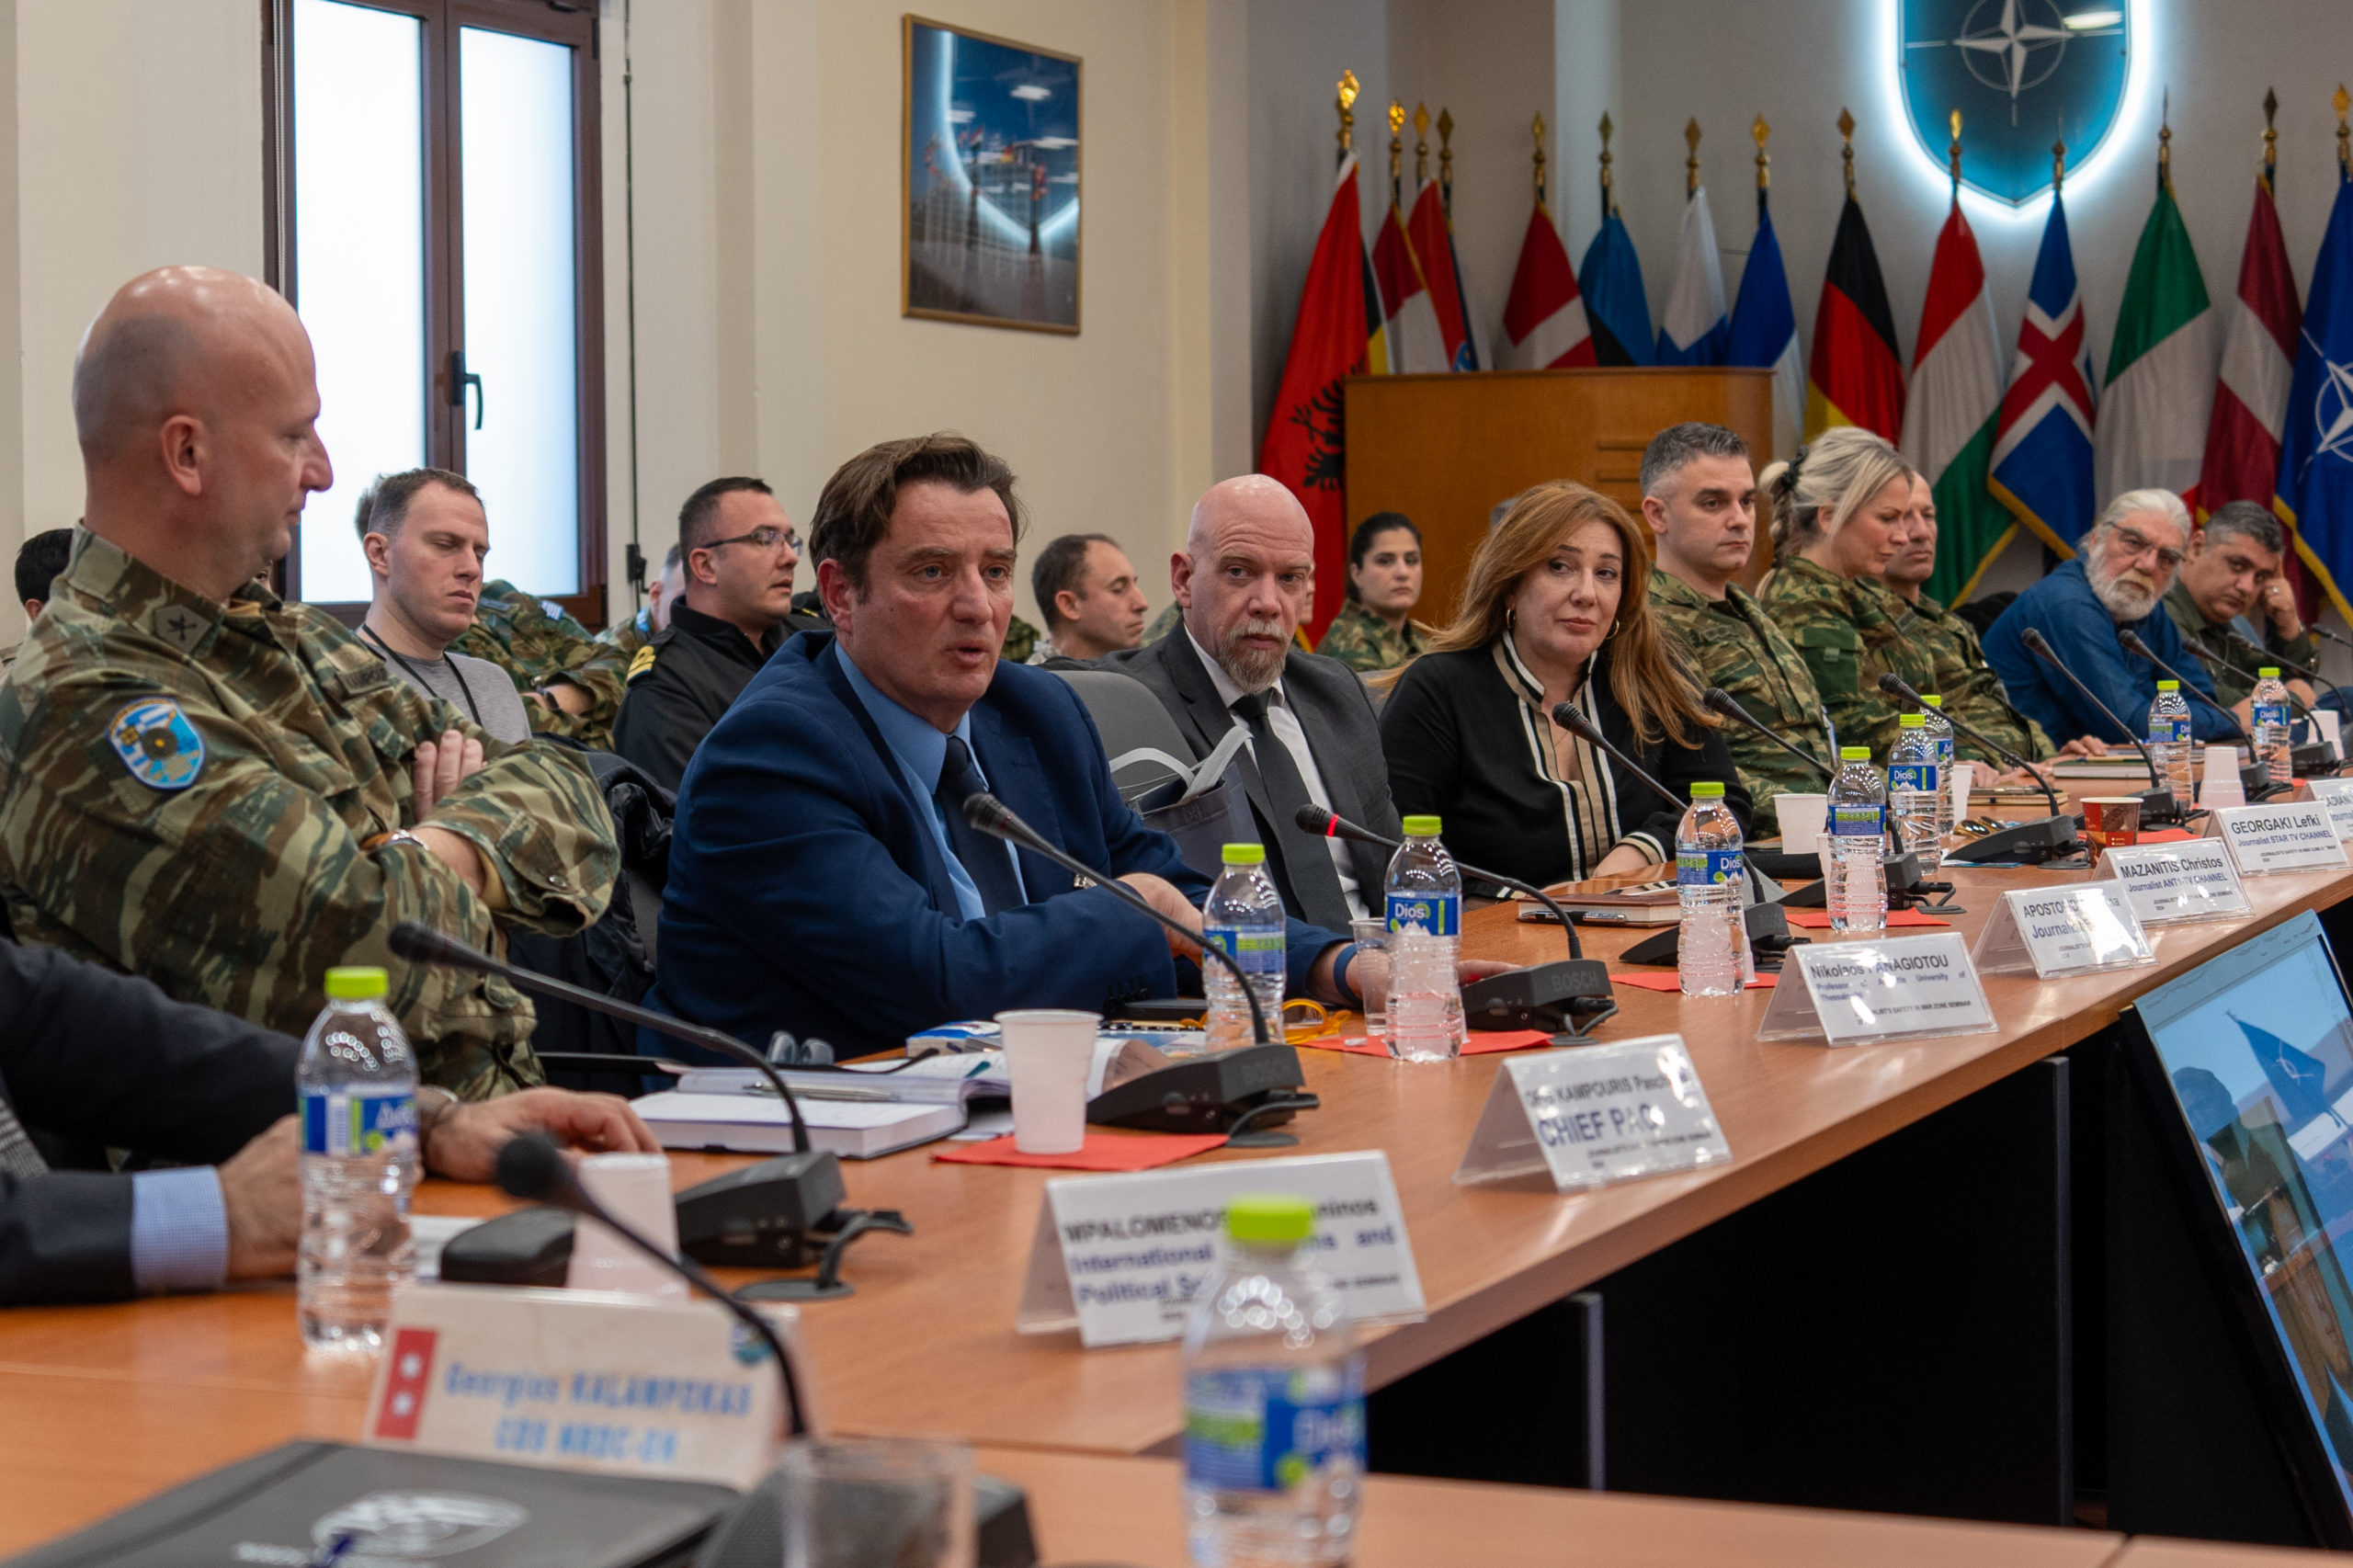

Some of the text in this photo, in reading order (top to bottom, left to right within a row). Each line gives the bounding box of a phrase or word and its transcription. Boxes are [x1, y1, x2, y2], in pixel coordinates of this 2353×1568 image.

[2232, 814, 2321, 834] GEORGAKI Lefki
[2238, 831, 2333, 846] Journalist STAR TV CHANNEL
[2120, 858, 2223, 879] MAZANITIS Christos
[2129, 881, 2163, 892] Journalist
[2194, 873, 2228, 884] CHANNEL
[1394, 903, 1426, 918] Dios
[1811, 954, 1949, 979] Nikolaos ANAGIOTOU
[1539, 1111, 1604, 1148] CHIEF
